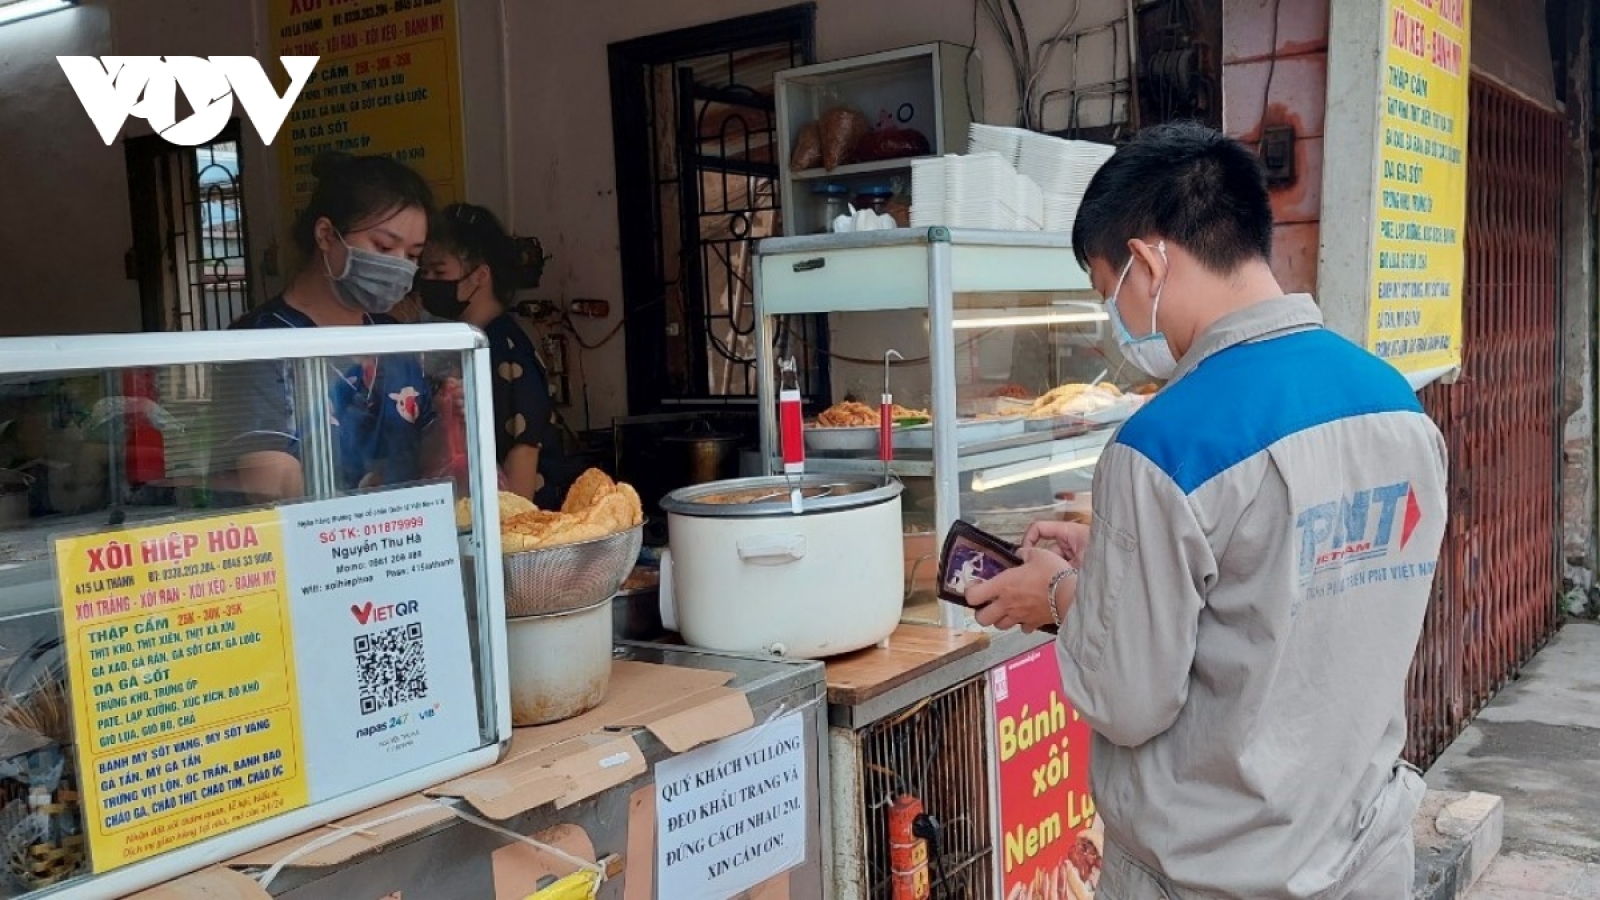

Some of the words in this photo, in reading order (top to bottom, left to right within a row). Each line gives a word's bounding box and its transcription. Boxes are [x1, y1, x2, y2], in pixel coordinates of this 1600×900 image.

[87, 541, 132, 572] XÔI
[140, 532, 198, 564] HIỆP
[207, 523, 257, 552] HÒA
[319, 528, 336, 543] Số
[338, 527, 360, 540] TK:
[363, 516, 423, 535] 011879999
[331, 539, 377, 559] Nguyễn
[380, 537, 403, 549] Thu
[405, 532, 421, 544] Hà
[88, 625, 128, 642] THẬP
[133, 616, 168, 634] CẨM
[177, 611, 195, 626] 25K
[93, 681, 113, 696] DA
[118, 675, 138, 690] GÀ
[143, 667, 169, 684] SỐT
[356, 721, 387, 739] napas
[999, 690, 1066, 762] Bánh
[262, 748, 281, 762] BAO
[1032, 736, 1069, 797] xôi
[662, 773, 692, 802] QUÝ
[695, 758, 742, 789] KHÁCH
[667, 809, 697, 833] ĐEO
[699, 788, 737, 819] KHẨU
[738, 774, 781, 802] TRANG
[783, 763, 799, 783] VÀ
[666, 838, 705, 867] ĐỨNG
[708, 820, 744, 848] CÁCH
[746, 805, 781, 829] NHAU
[1005, 812, 1061, 873] Nem
[707, 856, 731, 881] XIN
